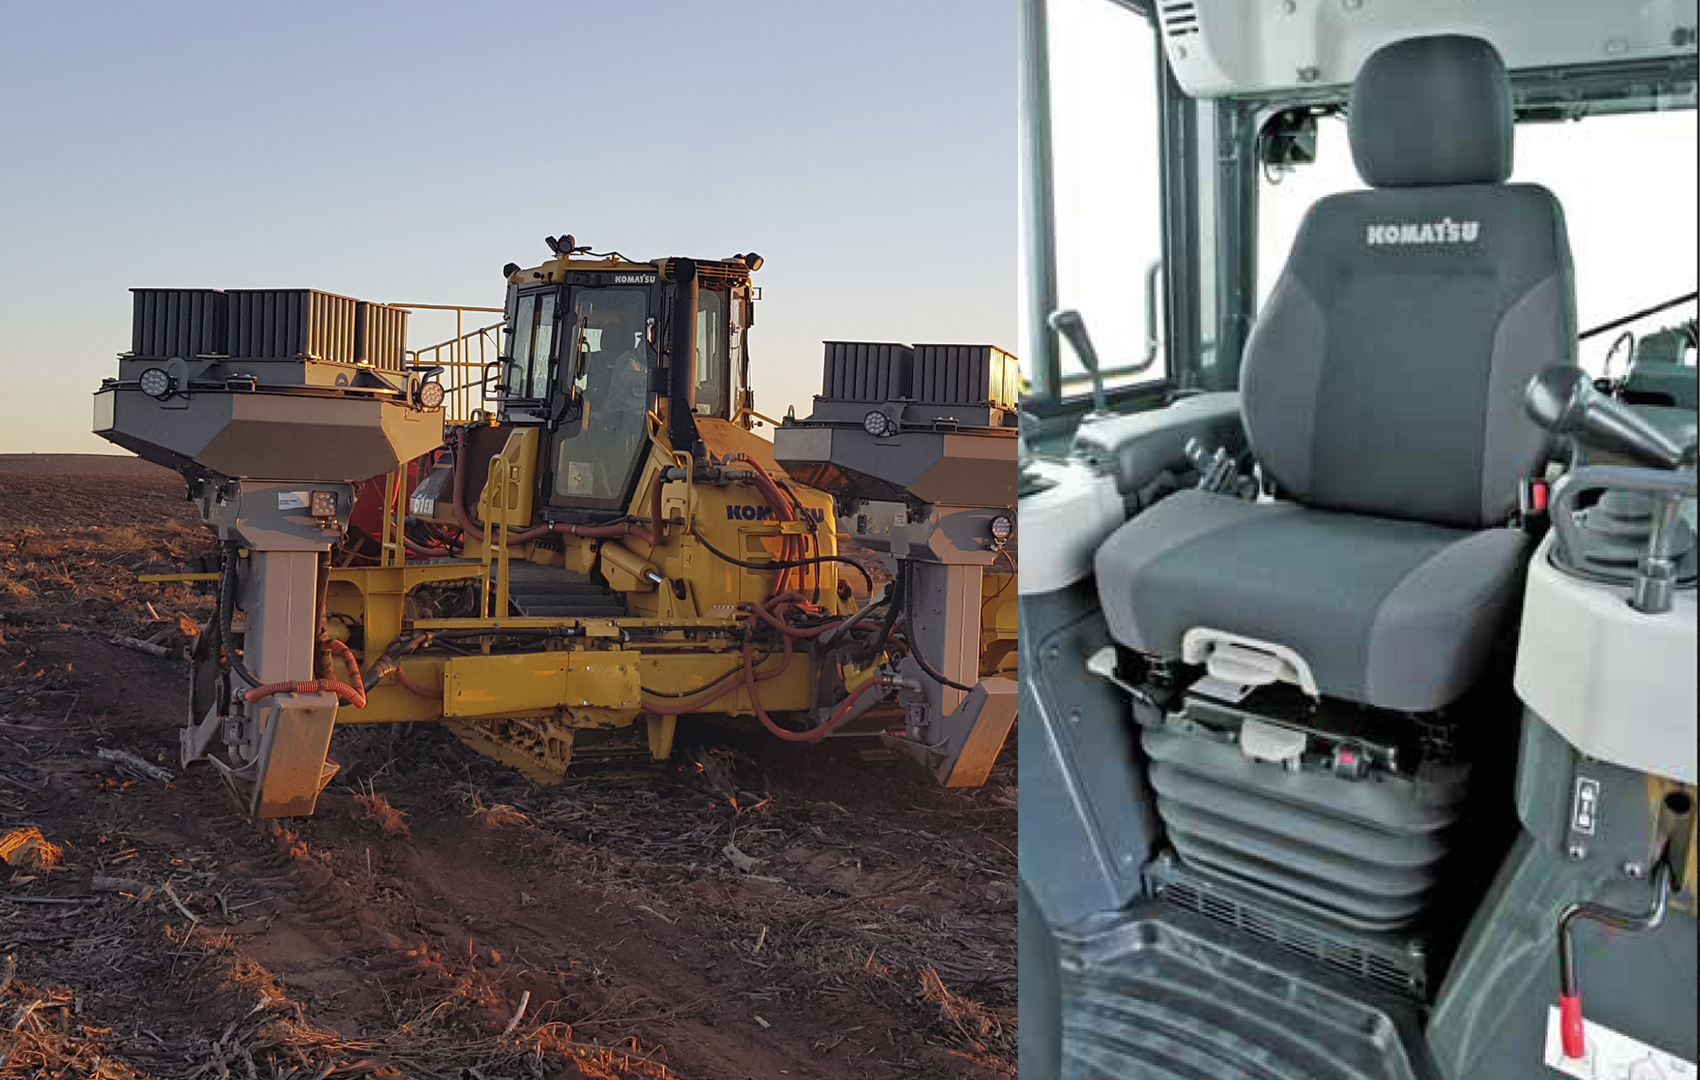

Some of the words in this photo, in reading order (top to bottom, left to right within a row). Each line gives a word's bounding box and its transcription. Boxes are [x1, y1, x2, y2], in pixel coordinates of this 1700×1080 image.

[1366, 217, 1478, 244] KOMATSU
[615, 274, 656, 284] KOMATSU
[726, 505, 825, 523] KOMSU
